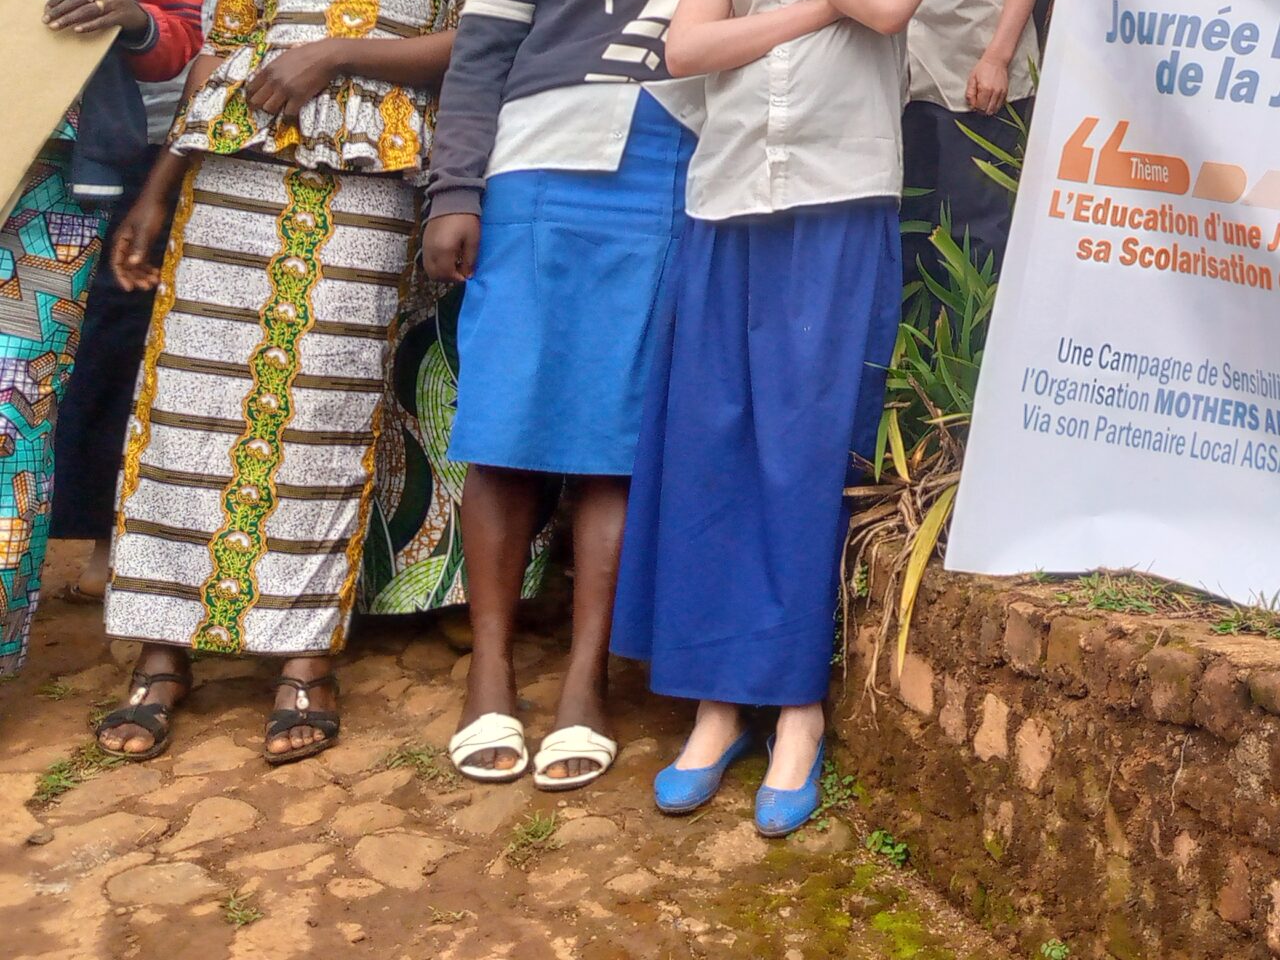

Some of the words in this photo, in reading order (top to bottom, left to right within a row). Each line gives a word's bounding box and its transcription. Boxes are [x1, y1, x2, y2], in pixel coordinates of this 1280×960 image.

[1105, 0, 1260, 56] Journée
[1155, 50, 1204, 97] de
[1215, 56, 1260, 104] la
[1130, 157, 1169, 183] Thème
[1048, 189, 1199, 238] L'Education
[1204, 212, 1262, 249] d'une
[1076, 238, 1112, 263] sa
[1118, 236, 1273, 290] Scolarisation
[1058, 337, 1094, 367] Une
[1098, 343, 1193, 385] Campagne
[1197, 359, 1218, 387] de
[1021, 367, 1150, 413] l'Organisation
[1153, 387, 1260, 431] MOTHERS
[1023, 403, 1051, 434] Via
[1056, 415, 1090, 439] son
[1094, 415, 1186, 456] Partenaire
[1190, 431, 1239, 465] Local
